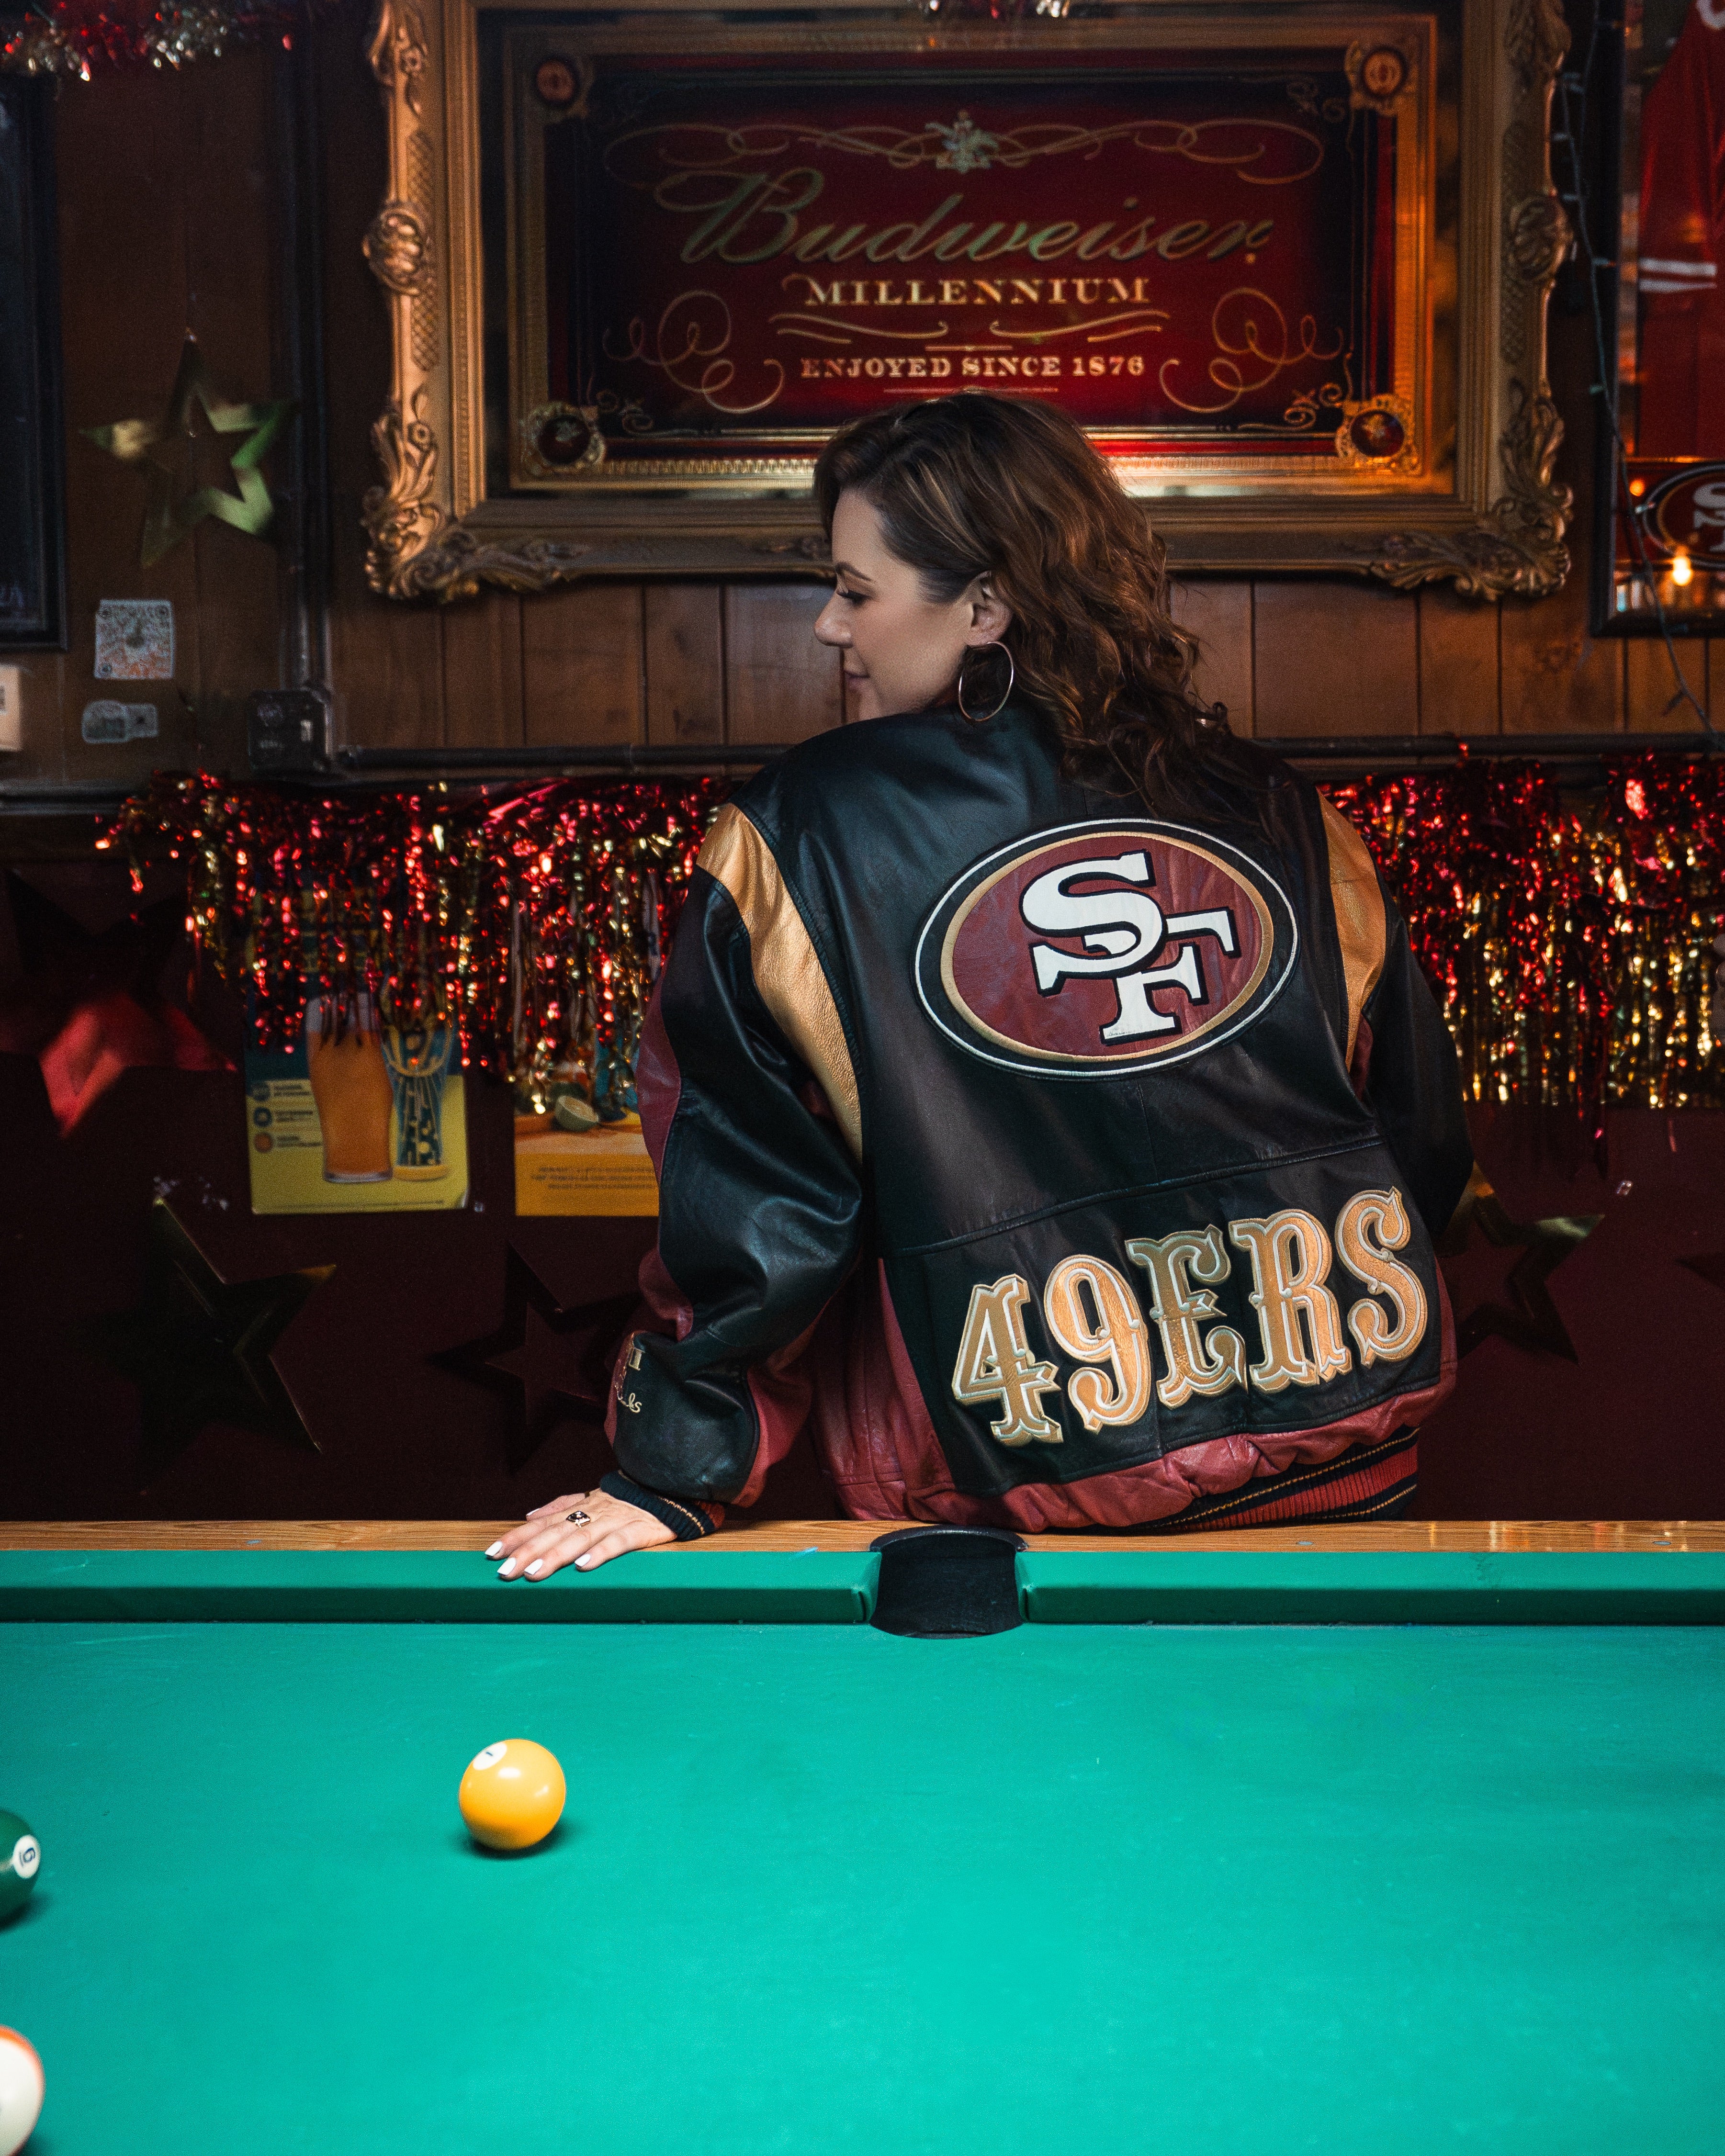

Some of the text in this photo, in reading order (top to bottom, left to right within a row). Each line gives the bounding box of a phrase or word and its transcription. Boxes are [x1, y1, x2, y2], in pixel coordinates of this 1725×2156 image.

[782, 274, 1151, 306] MILLENNIUM
[800, 356, 1145, 378] ENJOYED SINCE 1876
[1021, 850, 1240, 1044] SF
[952, 1186, 1428, 1446] 49ERS
